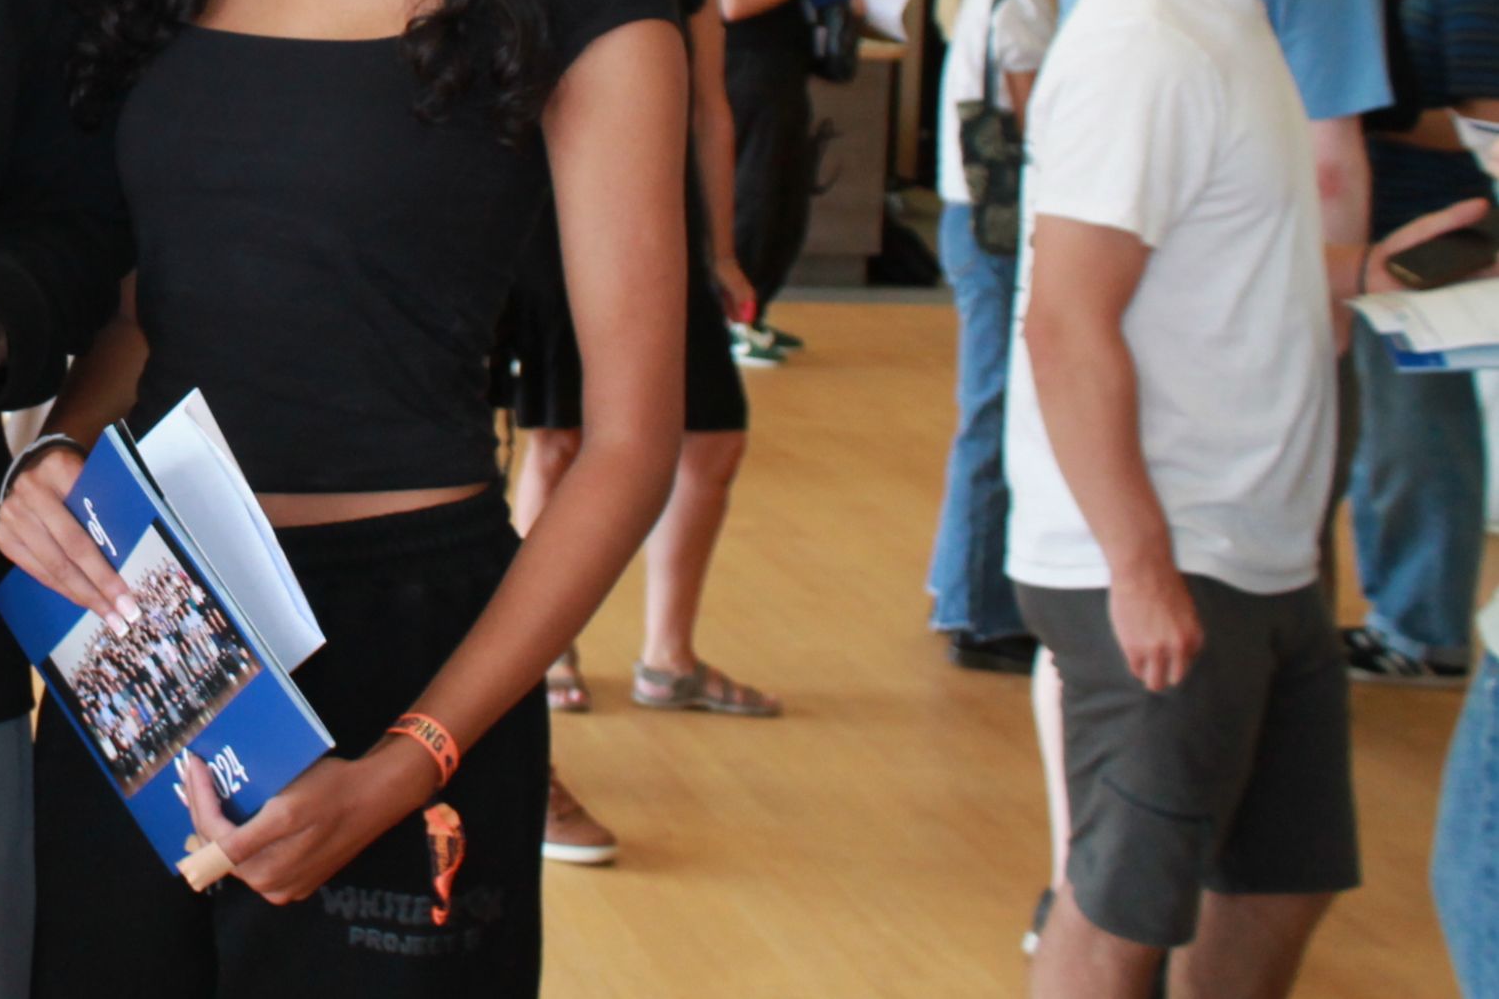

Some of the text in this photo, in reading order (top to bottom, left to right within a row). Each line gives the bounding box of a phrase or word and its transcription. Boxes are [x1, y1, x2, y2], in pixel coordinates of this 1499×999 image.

[205, 744, 250, 800] 024
[319, 884, 432, 927] WHITE
[347, 924, 457, 957] PROJECT
